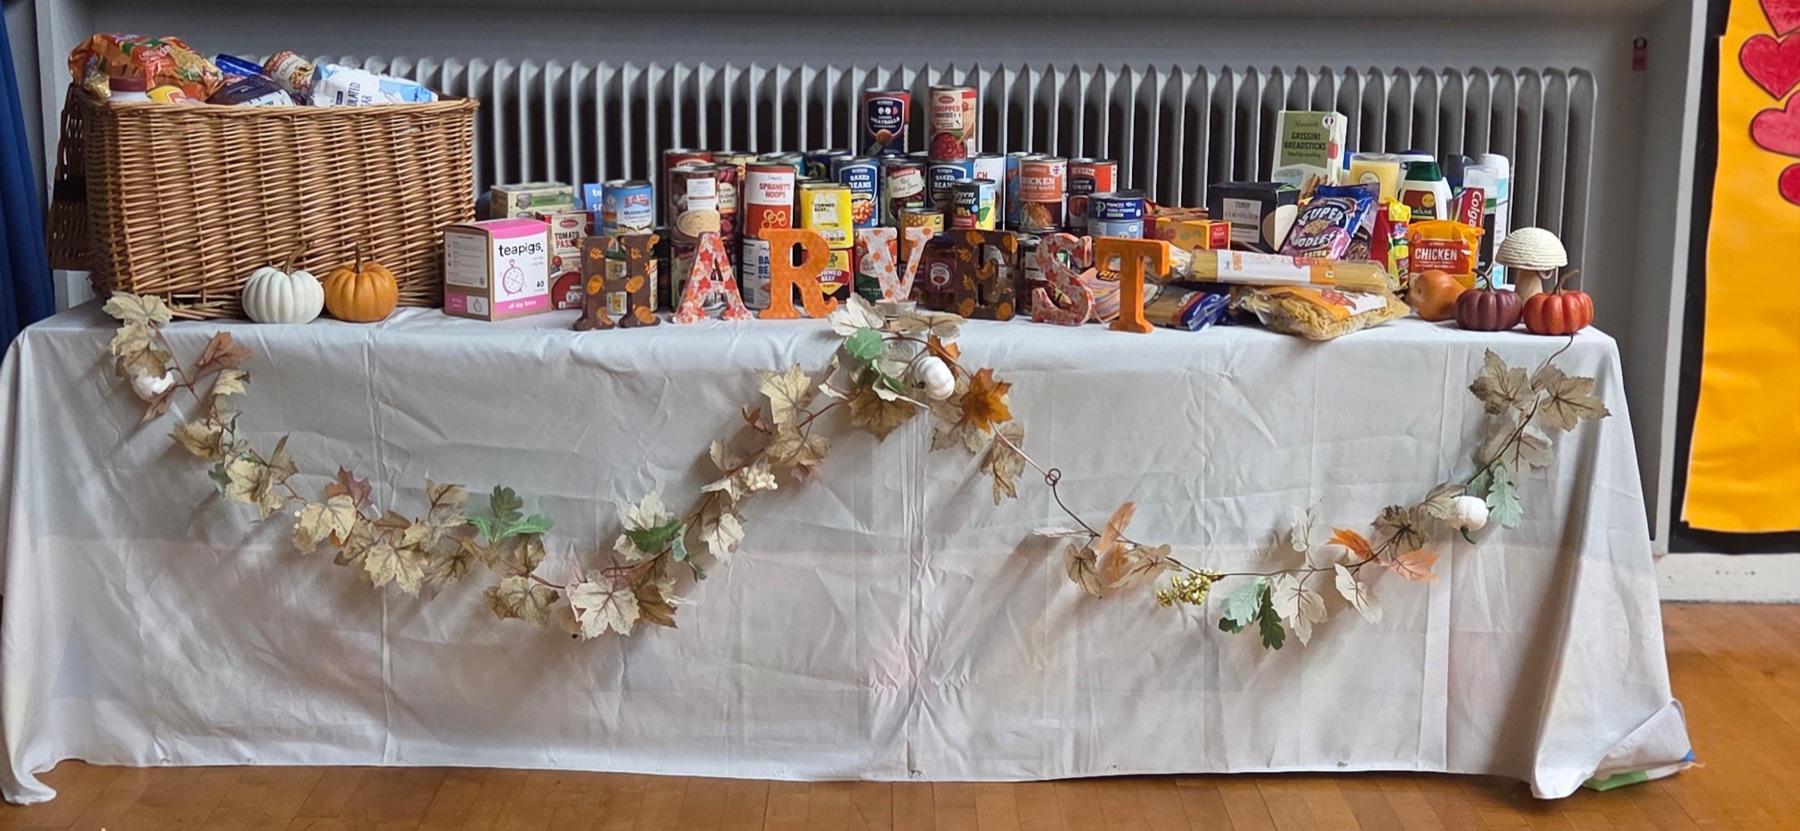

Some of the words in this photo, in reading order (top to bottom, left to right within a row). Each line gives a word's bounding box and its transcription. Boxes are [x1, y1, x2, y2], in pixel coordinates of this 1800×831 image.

[1284, 141, 1327, 150] BREADSTICKS
[934, 181, 953, 189] BEAN
[1467, 190, 1482, 227] Colga
[1298, 207, 1344, 226] SUPER
[554, 231, 580, 239] TOMATO
[498, 242, 544, 257] teapigs.
[1414, 248, 1457, 260] CHICKEN
[536, 280, 545, 288] 40
[573, 227, 1171, 334] HARVEST
